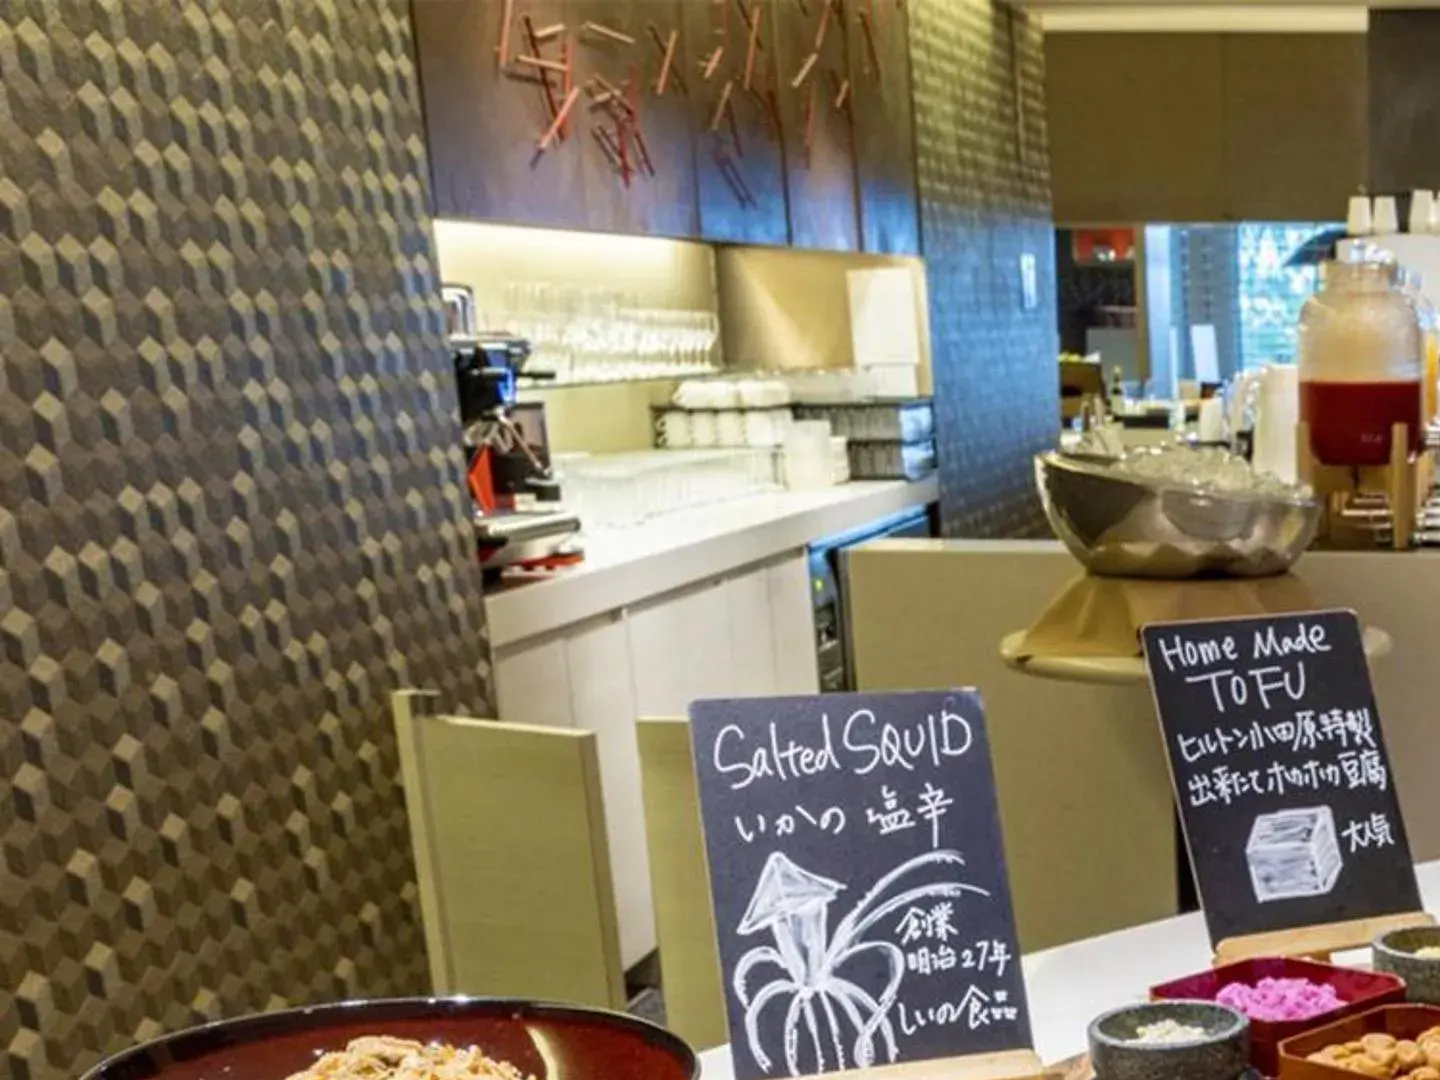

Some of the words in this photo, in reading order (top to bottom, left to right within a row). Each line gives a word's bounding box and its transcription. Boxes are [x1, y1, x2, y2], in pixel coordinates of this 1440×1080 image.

[1158, 631, 1240, 671] Home
[1252, 623, 1332, 659] Made
[1184, 661, 1306, 711] TOFU
[713, 714, 840, 789] Salted
[842, 708, 972, 775] SQUID
[895, 902, 959, 946] 創業
[907, 939, 1012, 977] 明治27年
